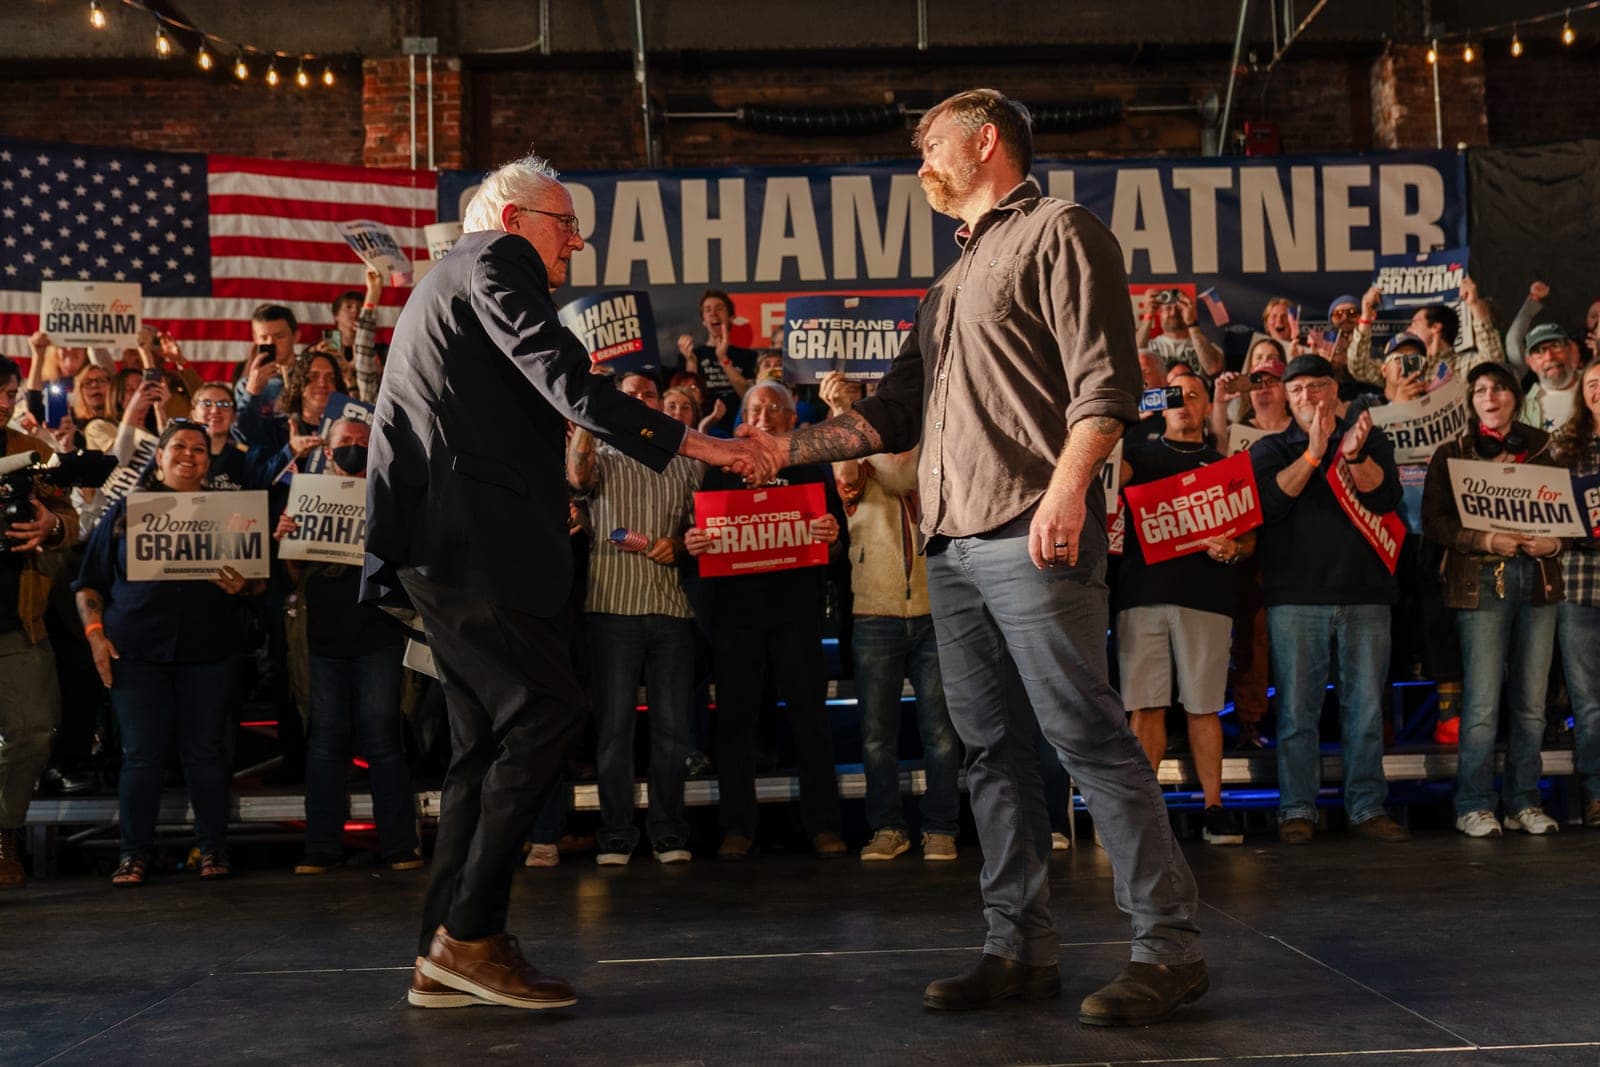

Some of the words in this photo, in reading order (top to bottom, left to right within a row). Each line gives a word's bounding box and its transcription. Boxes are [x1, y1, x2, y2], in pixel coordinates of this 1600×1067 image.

[459, 174, 934, 287] RAHAM
[1026, 164, 1446, 274] ATNER
[1377, 268, 1463, 294] GRAHAM
[51, 297, 106, 312] Women
[110, 299, 132, 313] for
[47, 313, 135, 334] GRAHAM
[585, 317, 642, 353] TNER
[597, 342, 635, 359] SENATE
[788, 330, 910, 360] GRAHAM
[1140, 485, 1224, 519] LABOR
[1462, 477, 1532, 499] Women
[1537, 485, 1562, 501] for
[298, 494, 365, 517] Women
[706, 511, 801, 526] EDUCATORS
[1141, 486, 1255, 544] GRAHAM
[1461, 493, 1573, 524] GRAHAM
[288, 515, 367, 545] GRAHA
[136, 532, 262, 560] GRAHAM
